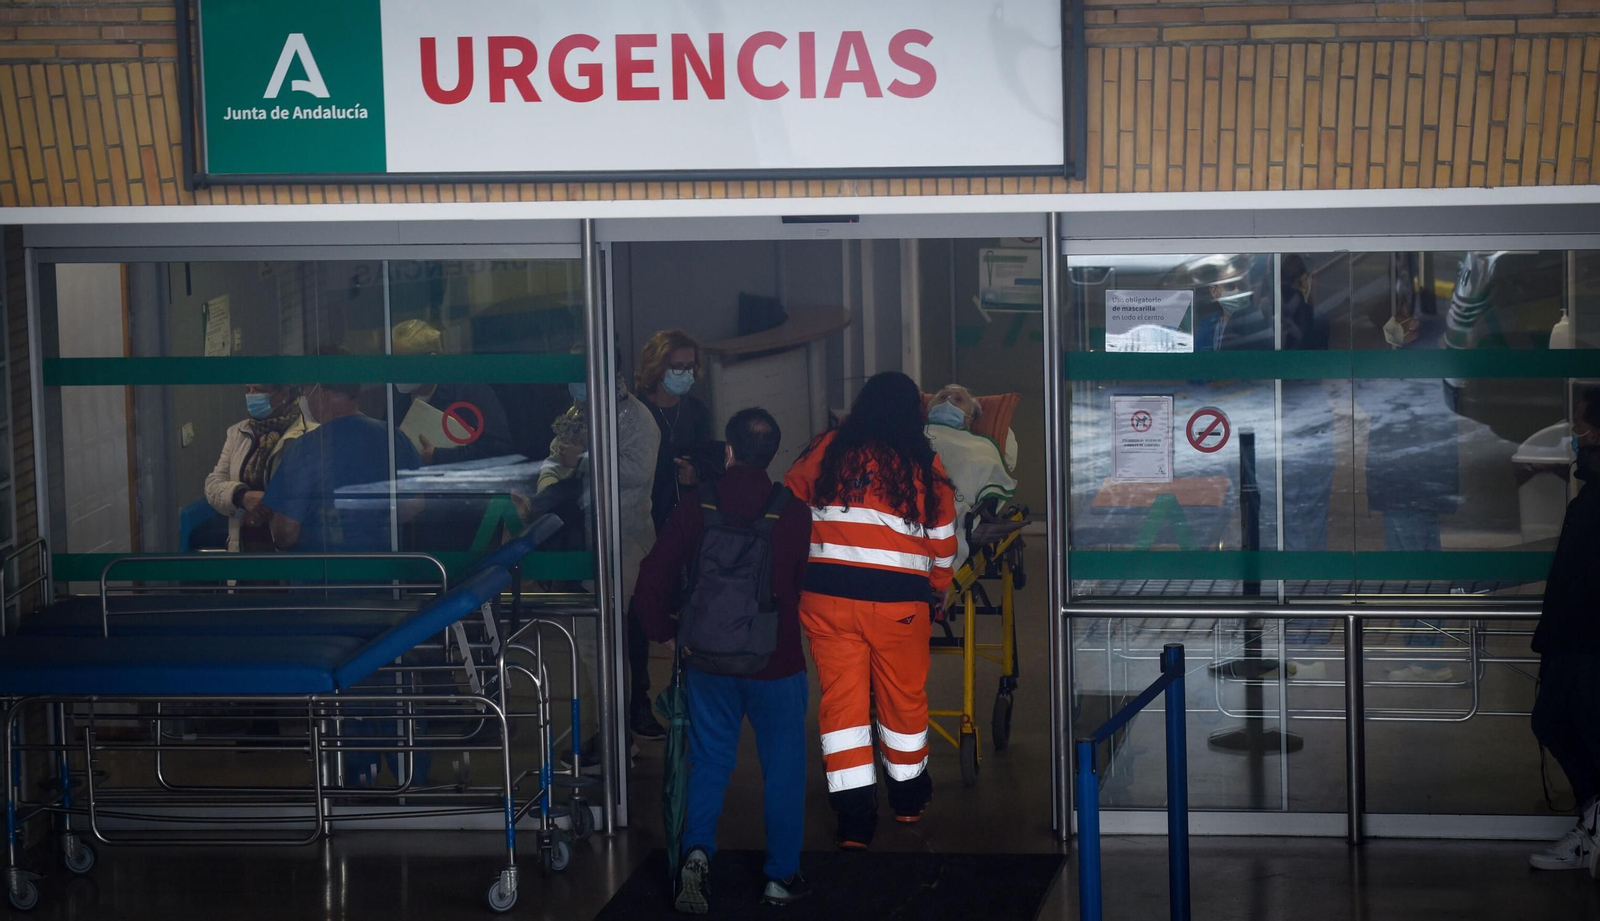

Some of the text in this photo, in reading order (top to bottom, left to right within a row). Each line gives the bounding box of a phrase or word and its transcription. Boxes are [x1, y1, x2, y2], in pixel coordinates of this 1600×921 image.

[420, 29, 936, 105] URGENCIAS
[223, 103, 368, 120] Junta de Andalucía
[1125, 296, 1162, 304] obligatorio
